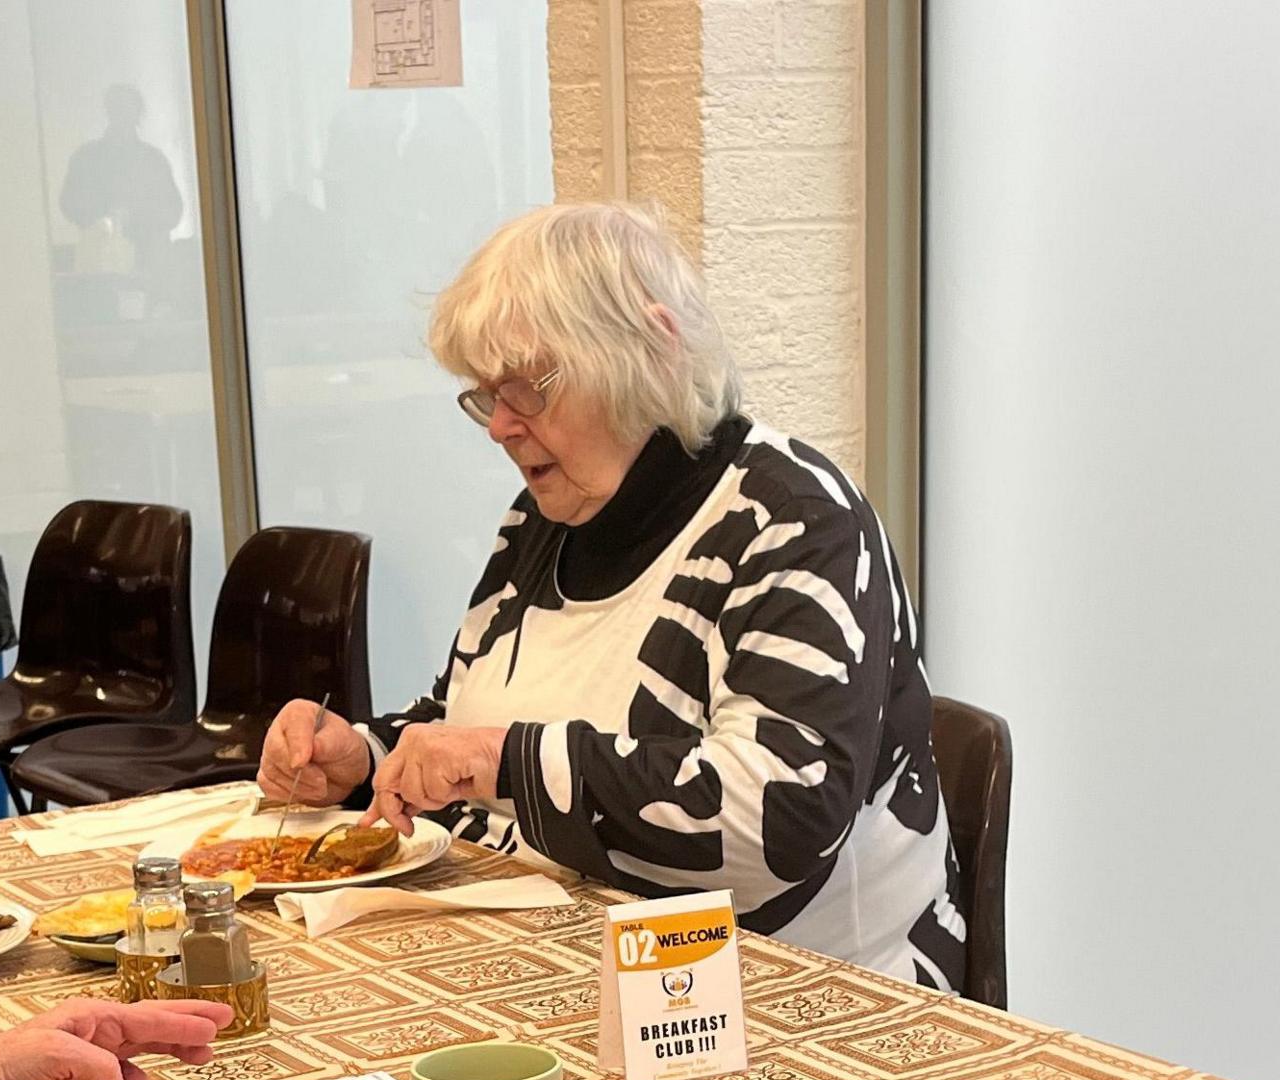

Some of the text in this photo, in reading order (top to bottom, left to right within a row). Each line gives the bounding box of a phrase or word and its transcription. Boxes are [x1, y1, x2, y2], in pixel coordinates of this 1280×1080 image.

[620, 923, 644, 933] TABLE
[618, 926, 729, 967] 02 WELCOME
[640, 1013, 728, 1042] BREAKFAST
[655, 1035, 716, 1059] CLUB !!!
